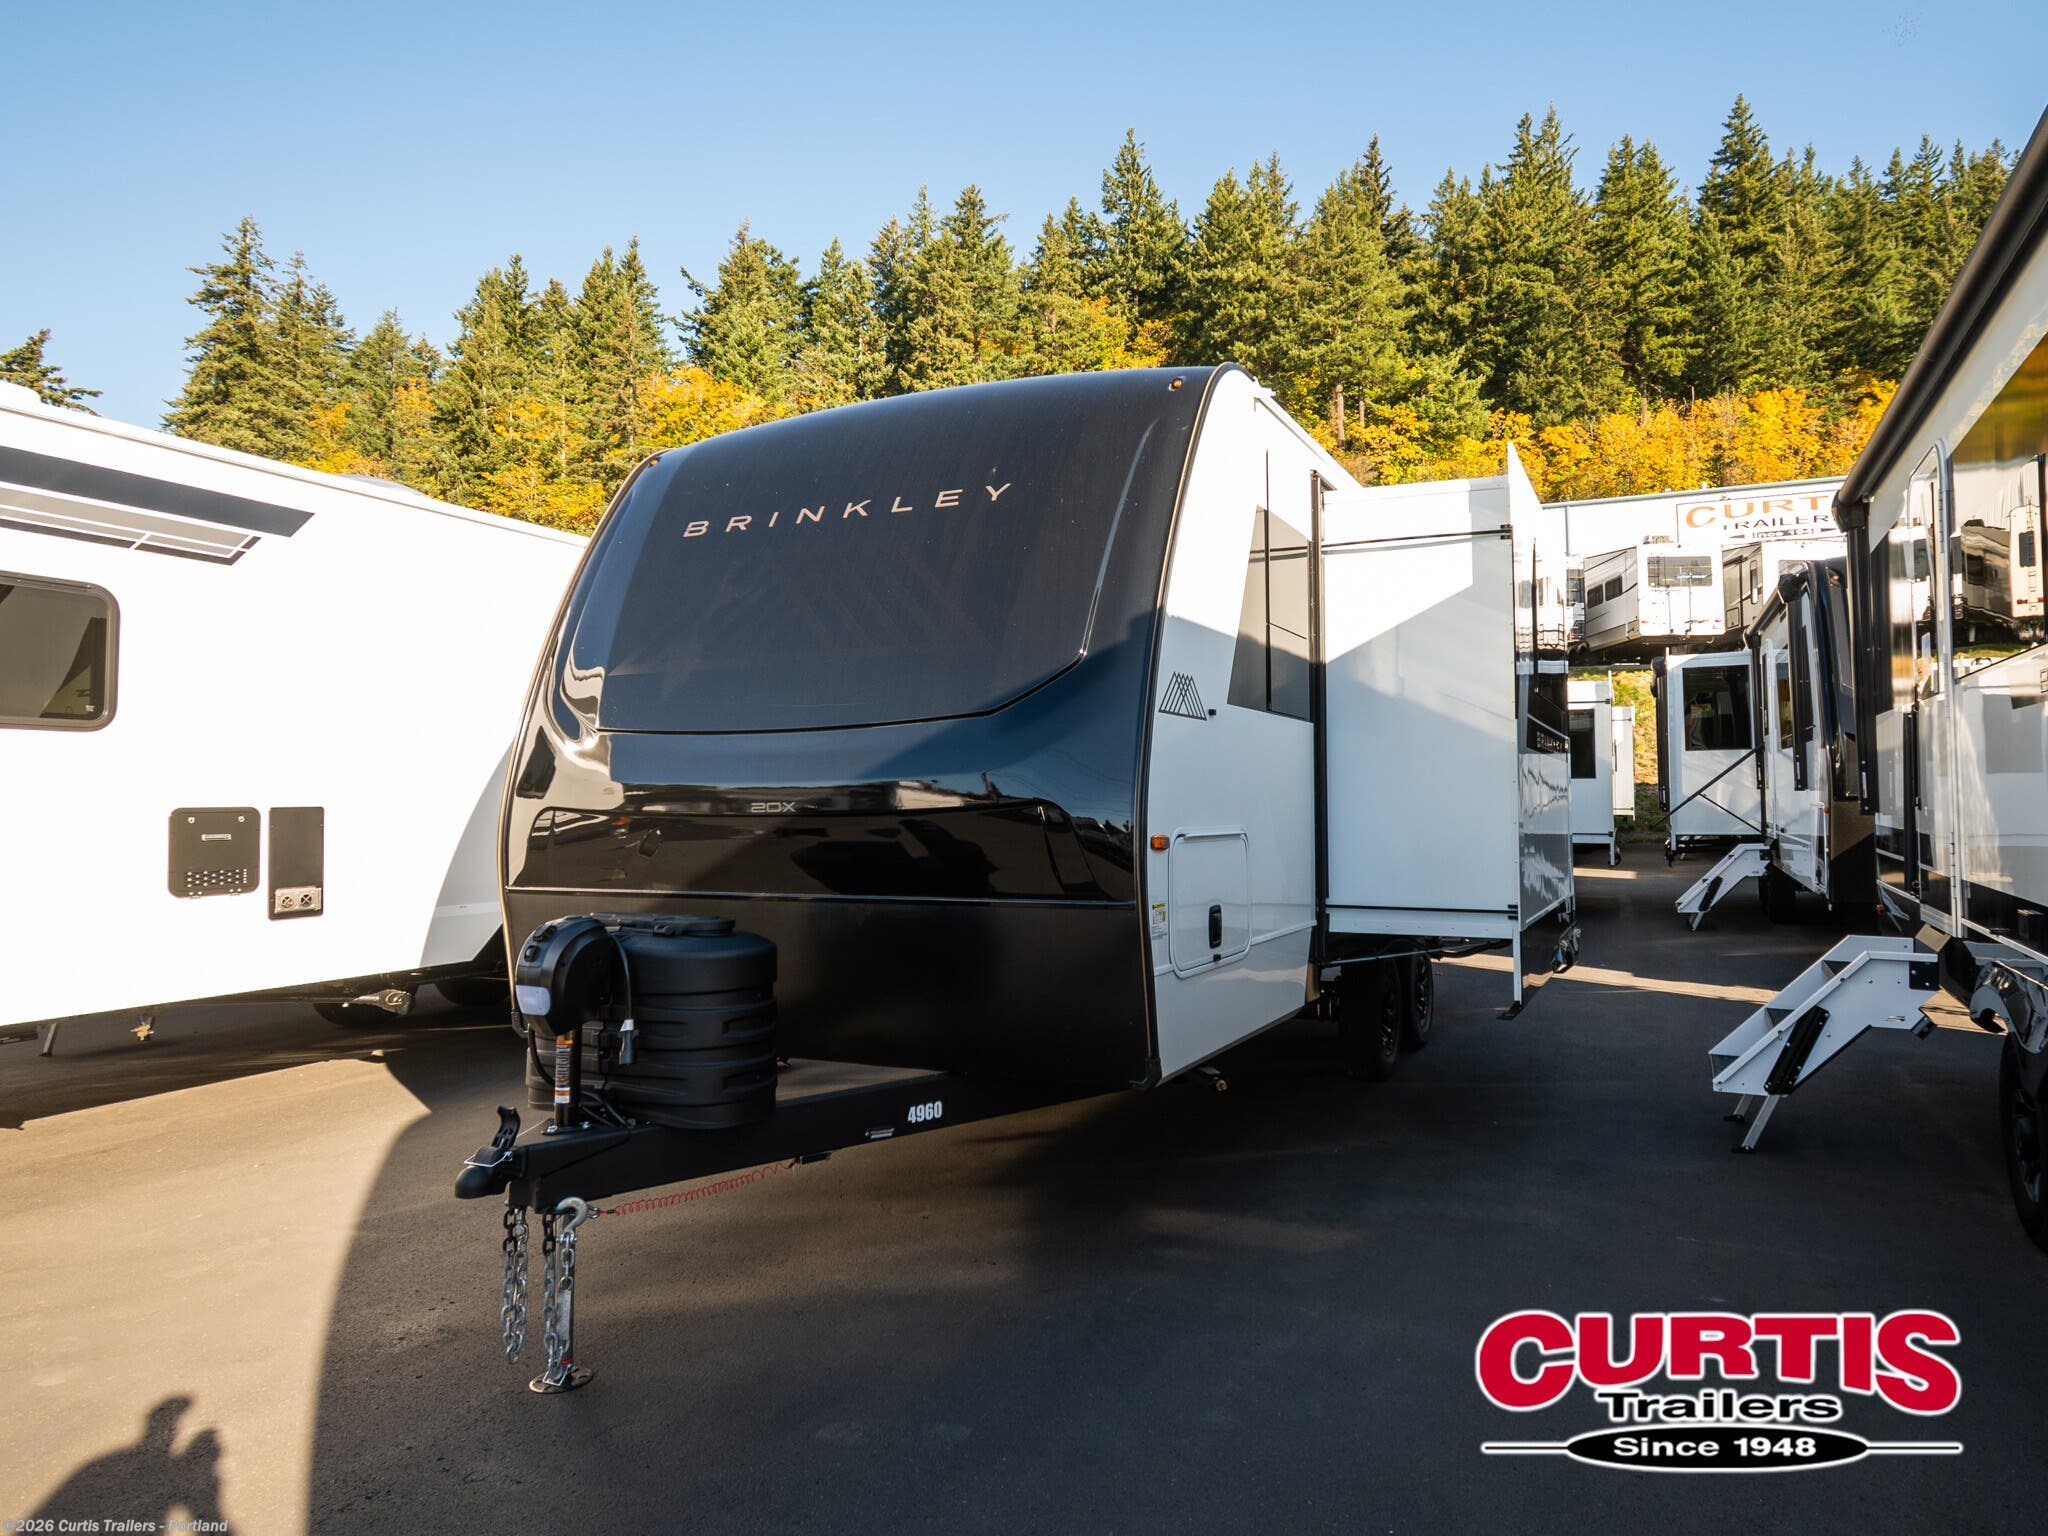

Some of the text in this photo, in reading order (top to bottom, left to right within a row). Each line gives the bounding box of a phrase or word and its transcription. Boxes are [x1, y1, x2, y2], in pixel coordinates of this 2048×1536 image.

[682, 483, 1012, 537] BRINKLEY
[1685, 495, 1830, 528] CURT
[751, 801, 796, 813] 20X
[907, 1100, 943, 1124] 4960
